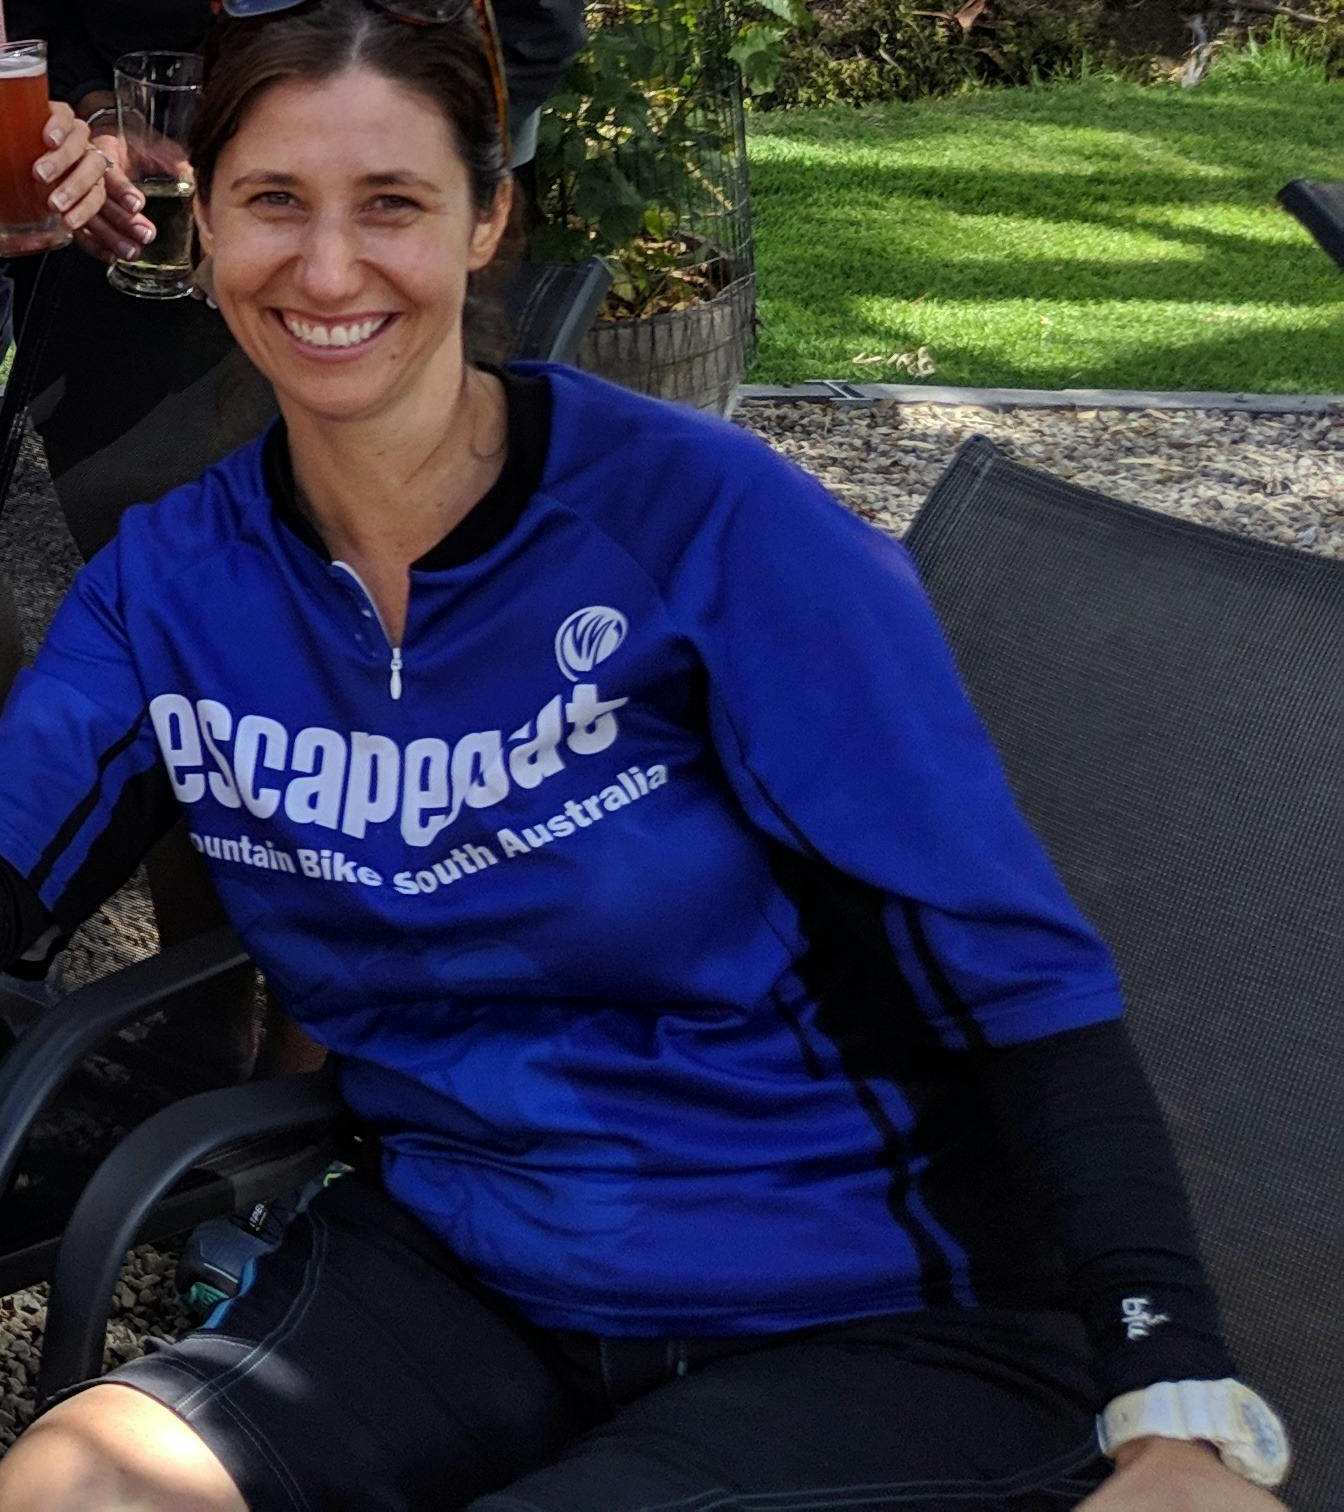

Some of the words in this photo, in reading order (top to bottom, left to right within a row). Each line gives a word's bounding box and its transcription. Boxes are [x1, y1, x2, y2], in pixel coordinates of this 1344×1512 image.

[189, 832, 296, 874] ountain
[297, 849, 383, 887] Bike
[393, 843, 499, 895] South
[496, 764, 669, 859] Australia
